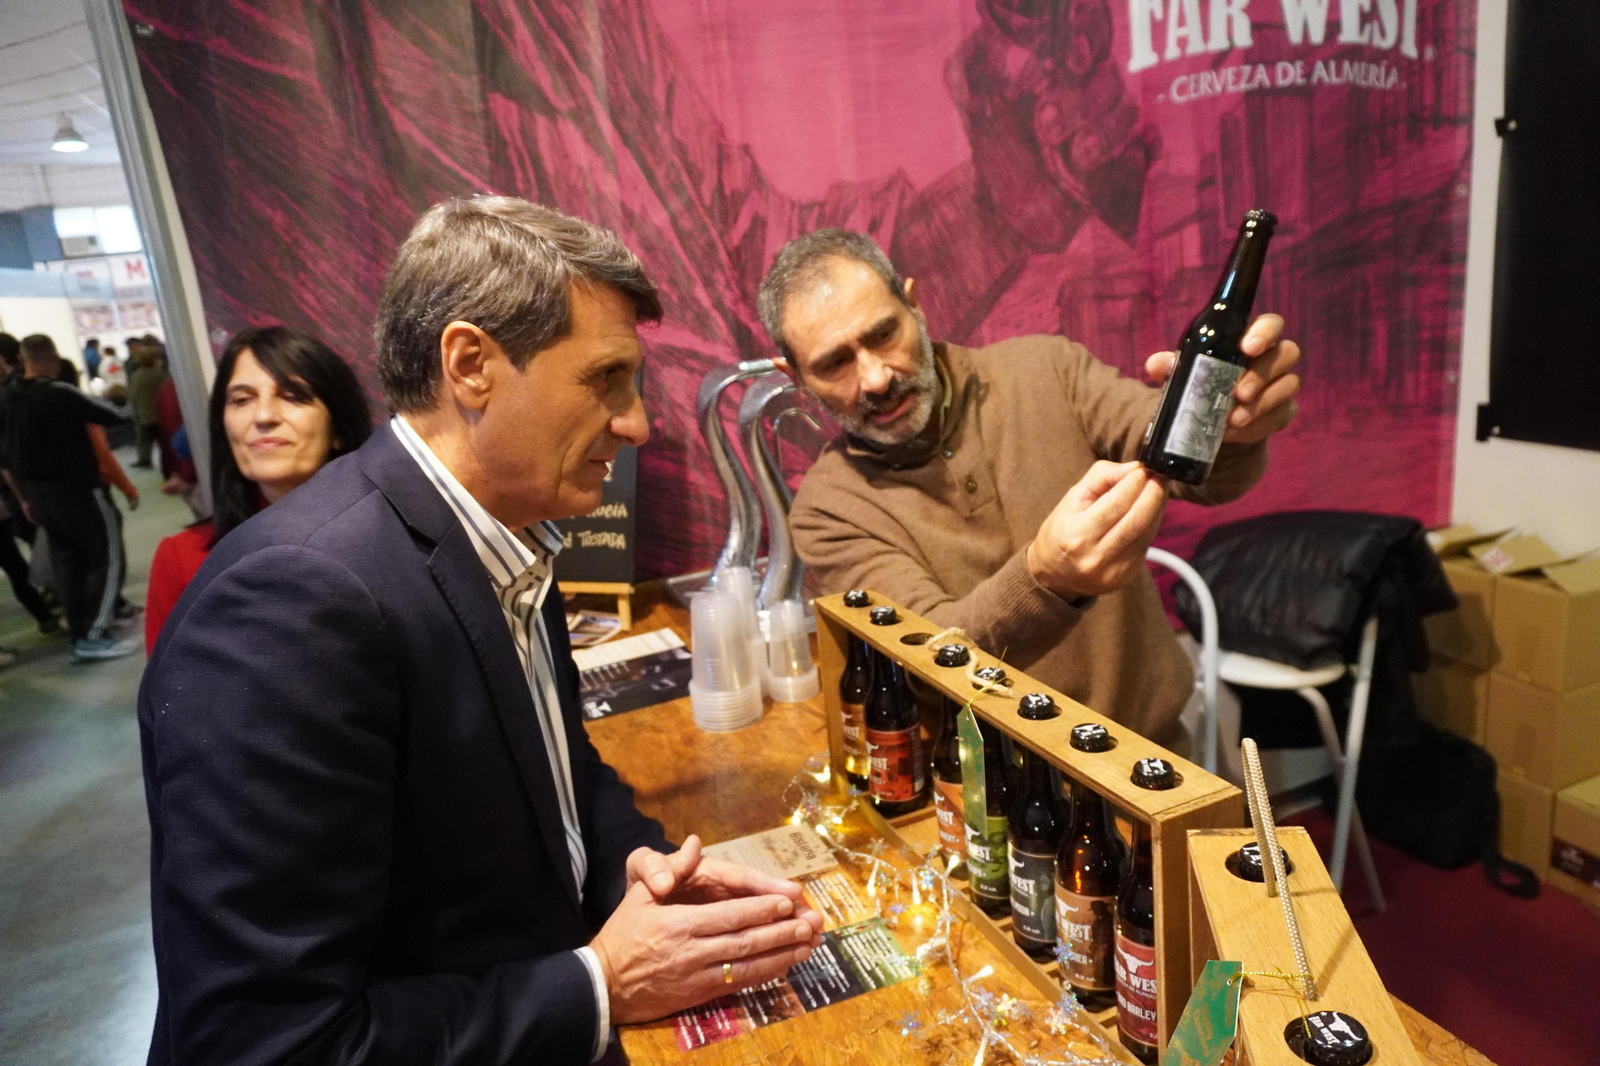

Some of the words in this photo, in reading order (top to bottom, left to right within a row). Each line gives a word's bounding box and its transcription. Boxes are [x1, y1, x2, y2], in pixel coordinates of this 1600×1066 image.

[1128, 0, 1253, 73] FAR
[1169, 61, 1271, 104] CERVEZA
[1274, 60, 1305, 87] DE
[1311, 59, 1399, 90] ALMERÍA
[1129, 972, 1157, 995] WES
[1127, 1001, 1157, 1021] BARLEY
[1307, 1016, 1325, 1028] FAR
[1320, 1027, 1341, 1045] WEST
